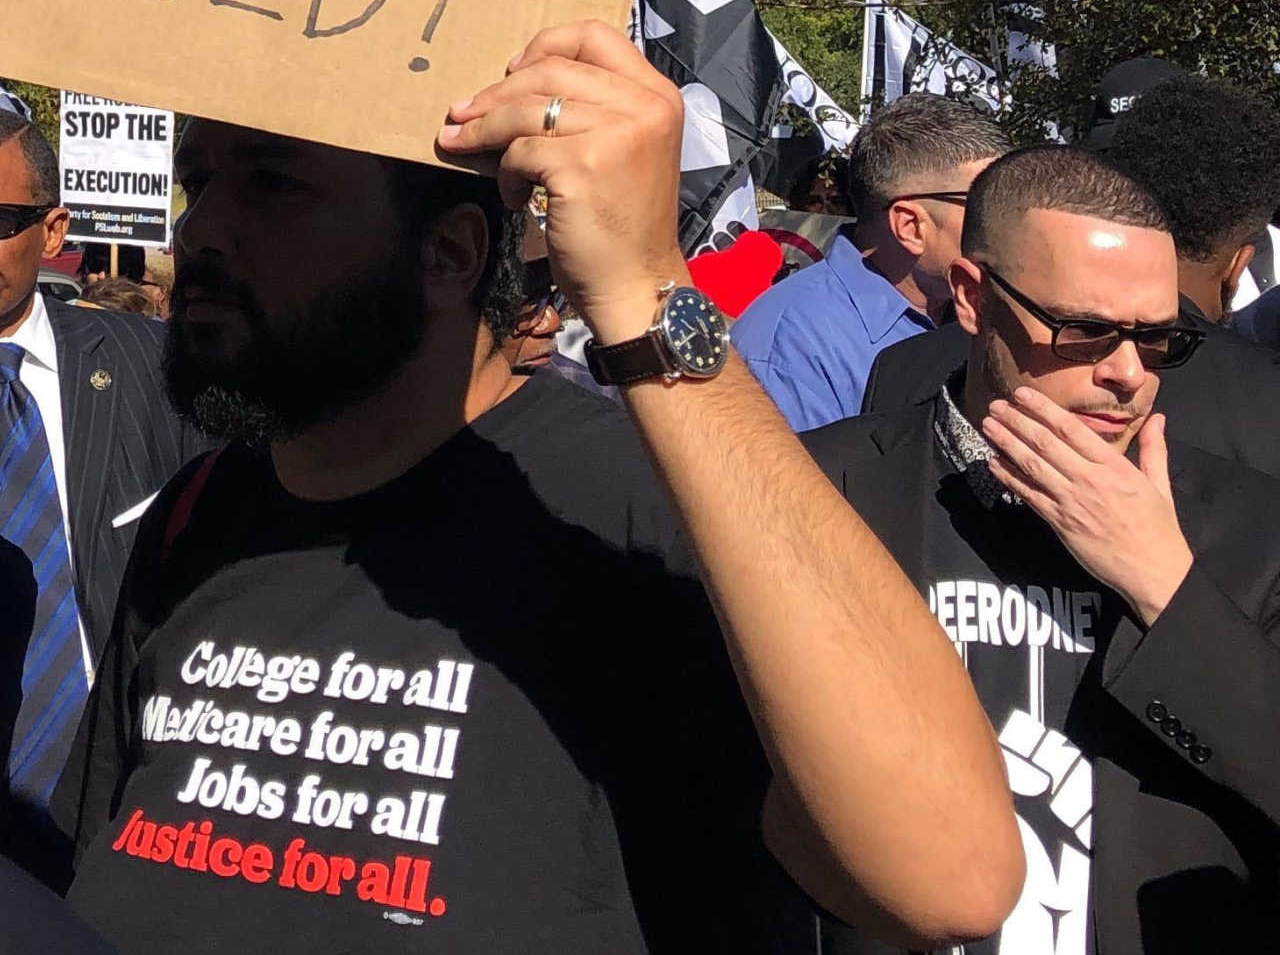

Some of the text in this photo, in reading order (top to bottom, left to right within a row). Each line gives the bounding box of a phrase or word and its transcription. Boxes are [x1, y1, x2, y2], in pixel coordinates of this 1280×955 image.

[65, 111, 167, 141] STOP THE
[64, 168, 168, 197] EXECUTION!
[67, 210, 81, 220] arty
[82, 209, 91, 220] for
[92, 210, 120, 222] Socialism
[134, 213, 165, 225] Liberation
[929, 580, 1102, 653] EERODNE
[180, 640, 475, 714] College for all
[305, 711, 384, 766] for
[382, 725, 461, 780] all
[176, 757, 447, 846] Jobs for all
[278, 838, 356, 896] for
[355, 855, 447, 918] all.
